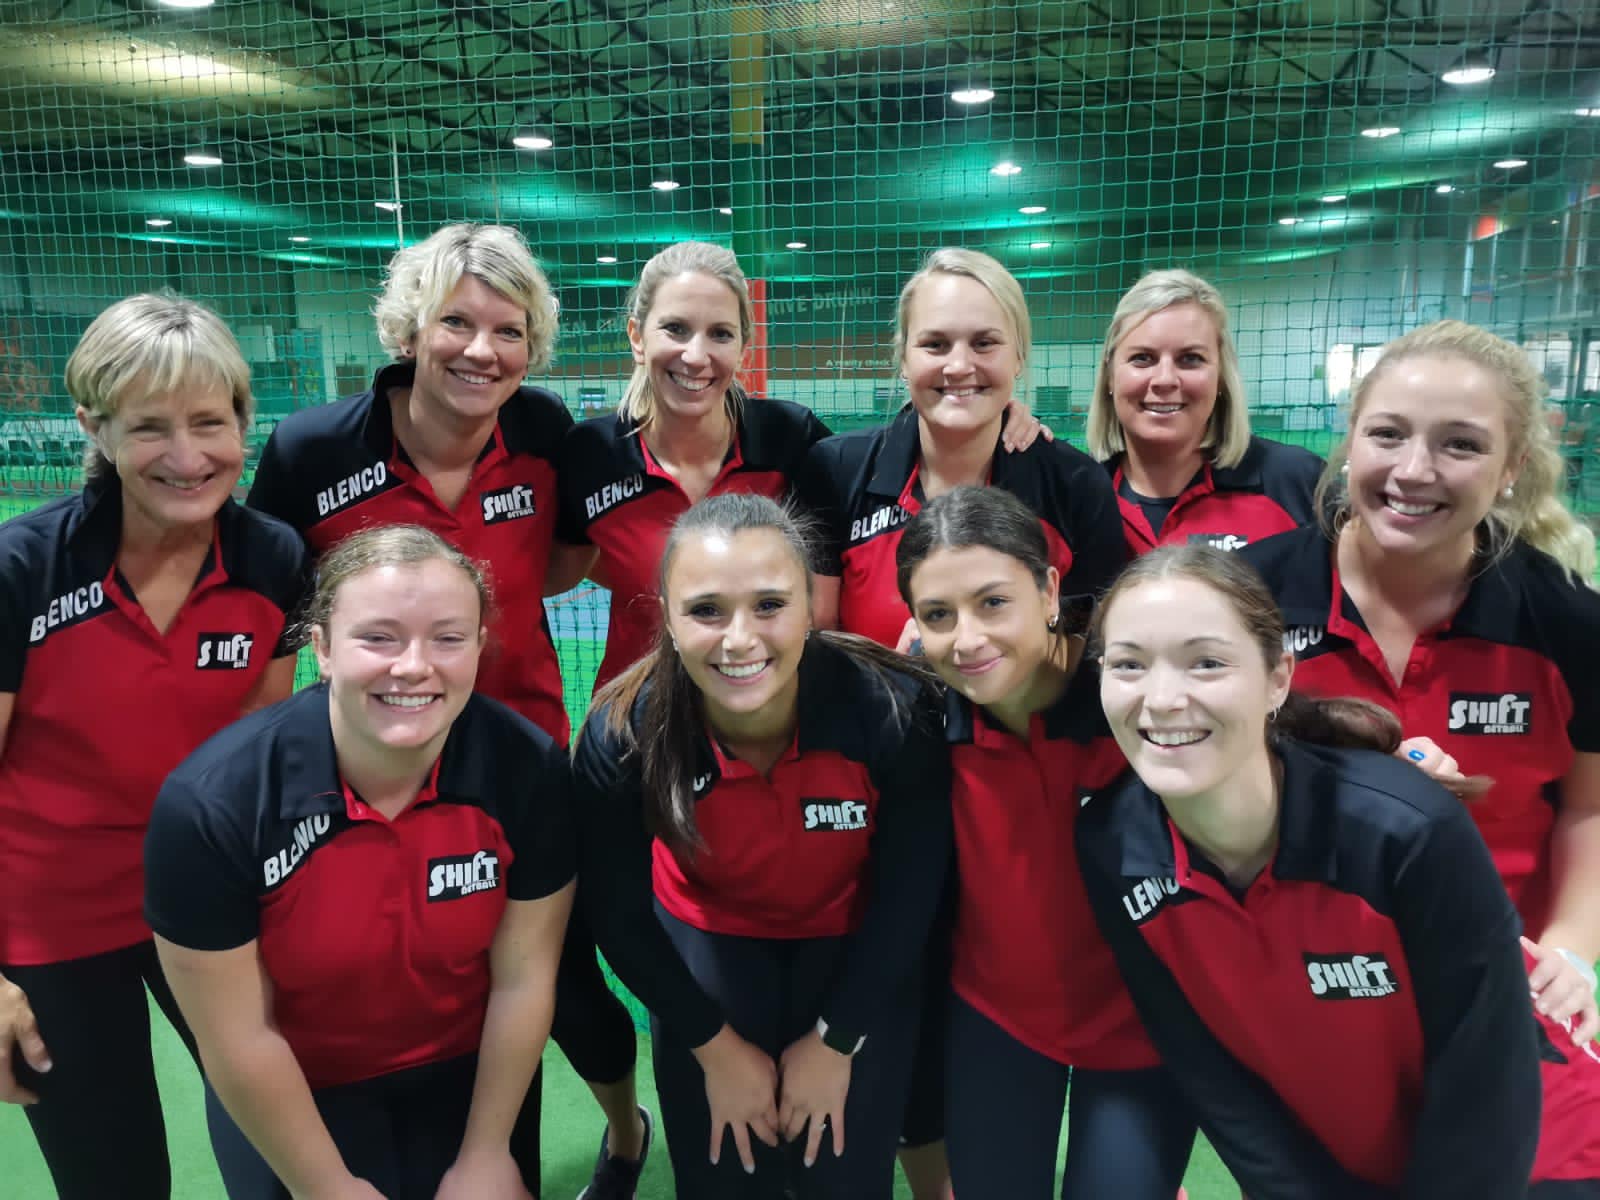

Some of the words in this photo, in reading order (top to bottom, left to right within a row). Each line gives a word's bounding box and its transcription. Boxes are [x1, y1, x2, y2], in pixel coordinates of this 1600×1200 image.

[316, 461, 387, 516] BLENCO
[585, 474, 643, 519] BLENCO
[29, 581, 104, 642] BENCO
[1122, 877, 1180, 920] LENO
